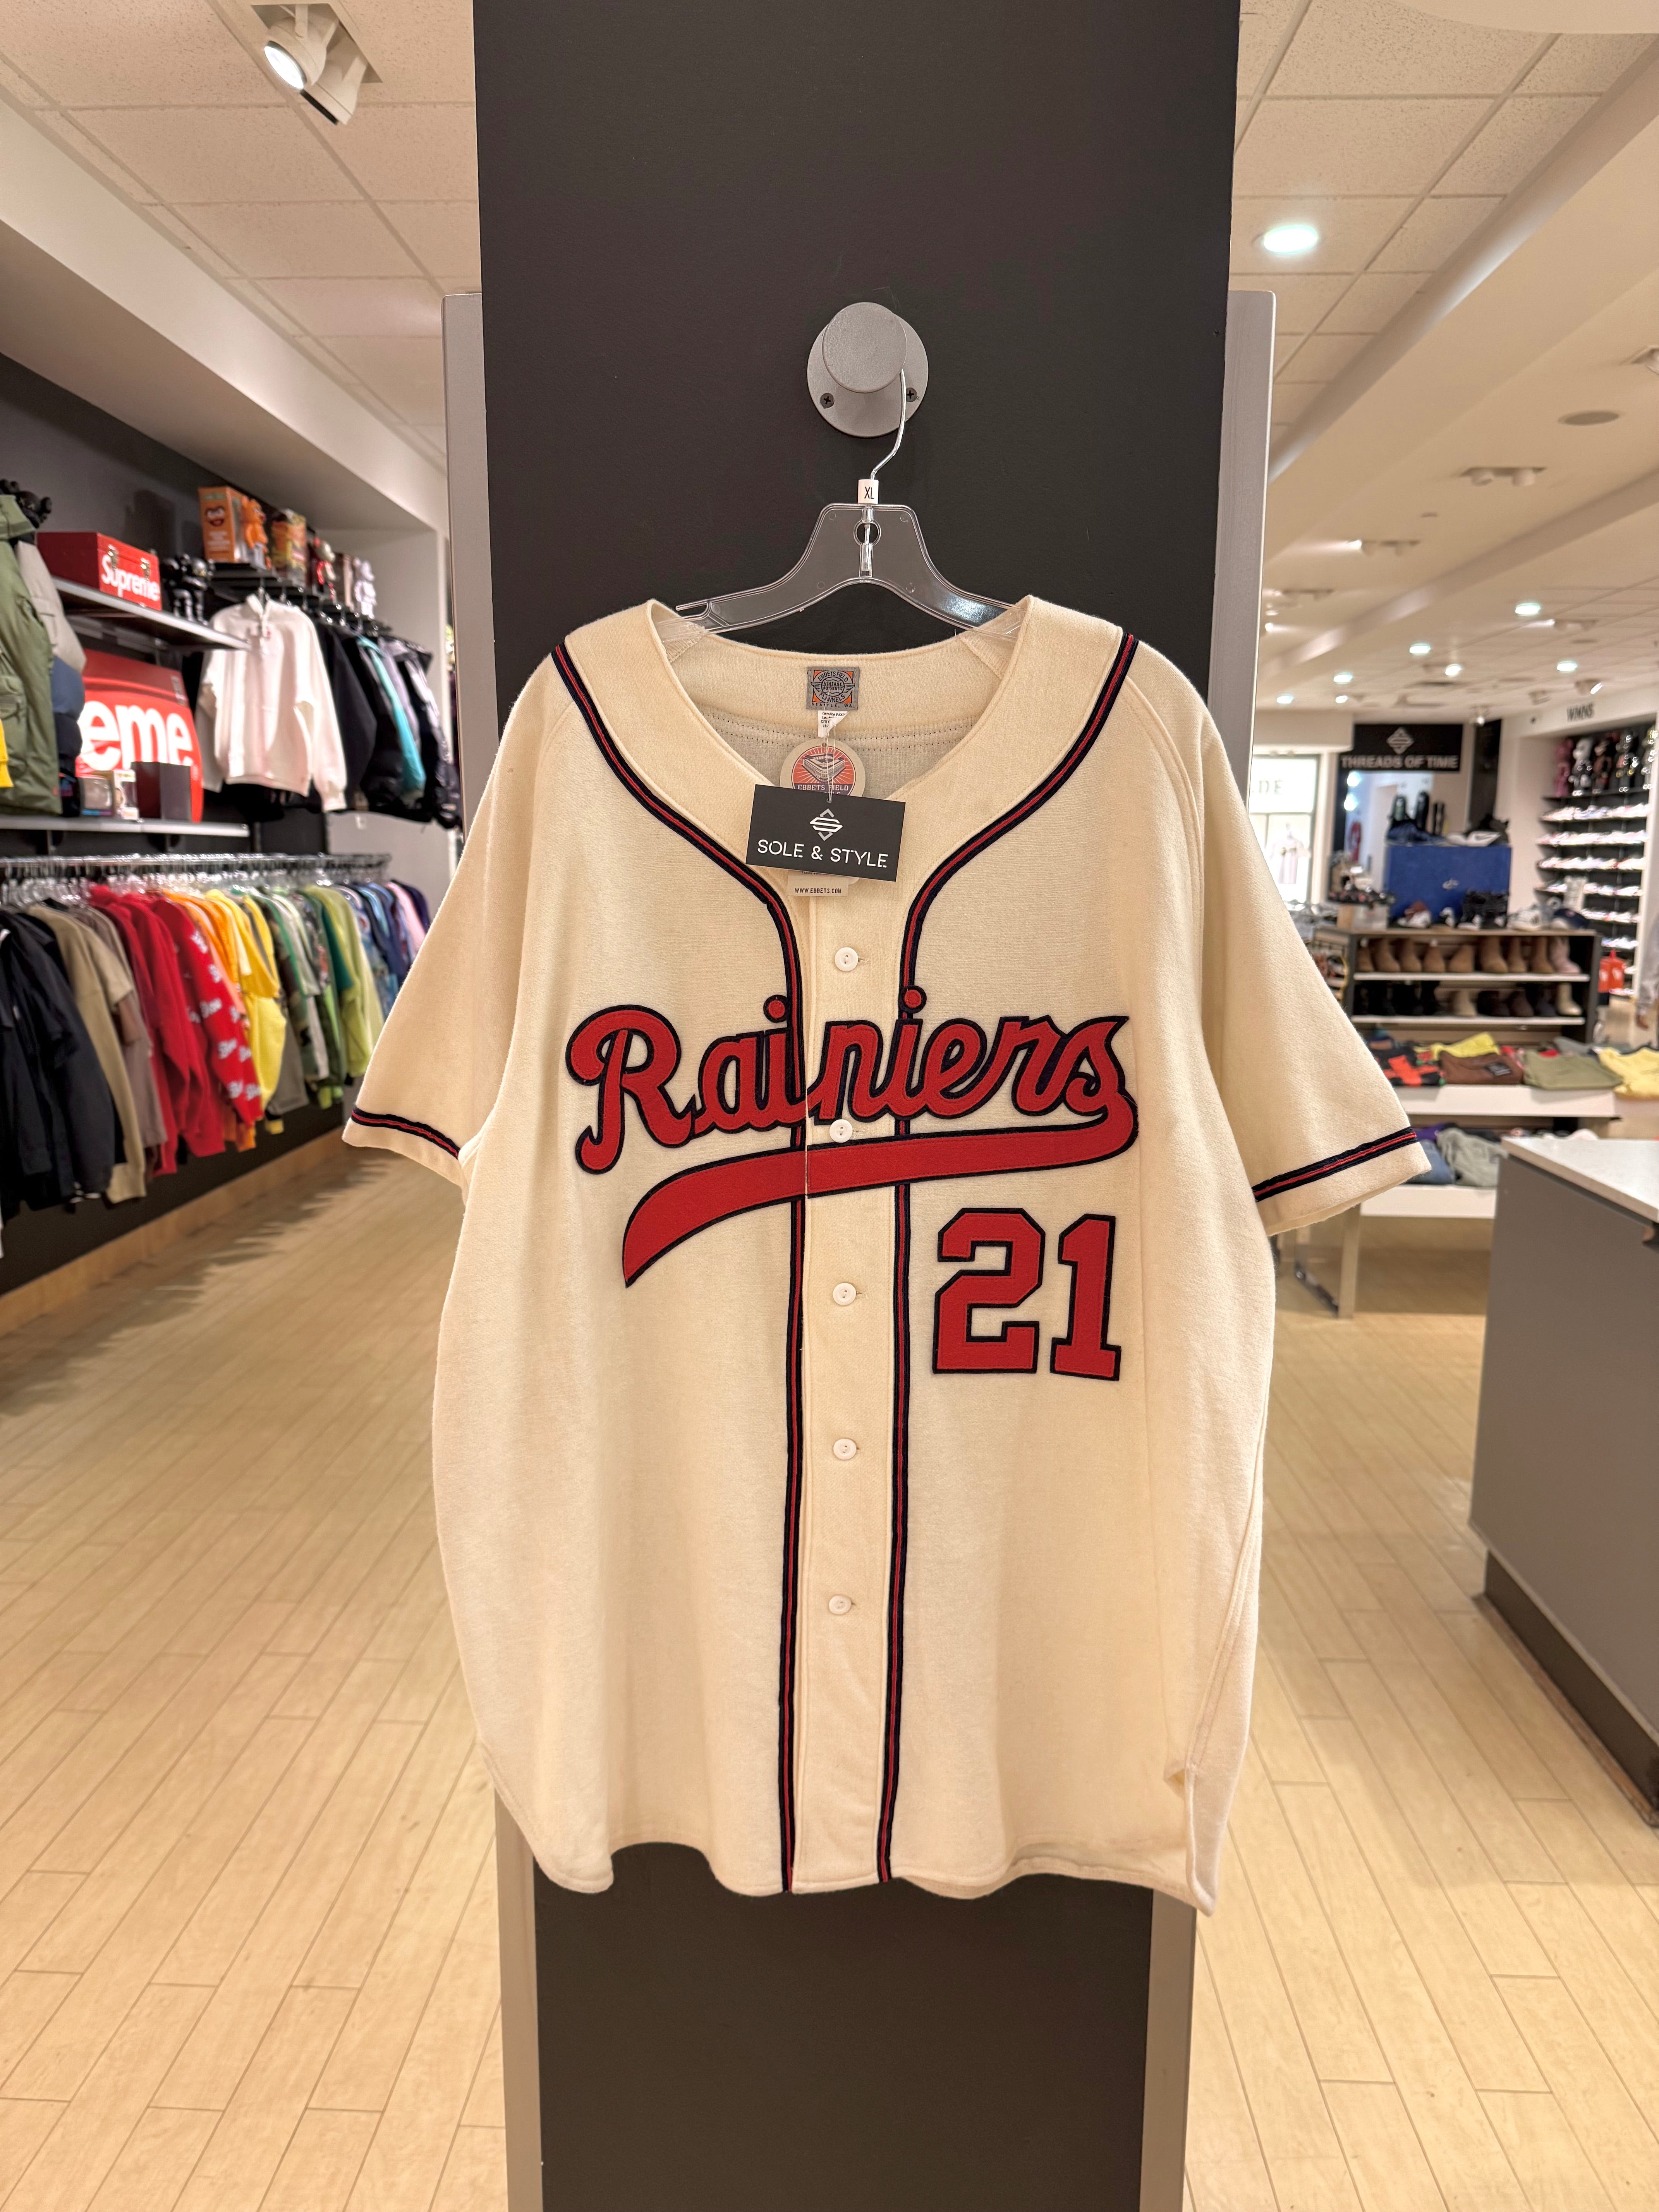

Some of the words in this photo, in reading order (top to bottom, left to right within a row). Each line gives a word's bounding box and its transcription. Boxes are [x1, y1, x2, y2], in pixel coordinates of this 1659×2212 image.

[864, 486, 874, 499] XL
[101, 554, 160, 601] Supreme
[818, 671, 836, 681] EBBETS
[836, 672, 848, 682] FIELD
[1567, 701, 1595, 722] WMNS
[1341, 756, 1403, 768] THREADS
[1405, 756, 1425, 768] OF
[1427, 755, 1459, 768] TIME
[757, 839, 804, 858] SOLE
[811, 846, 823, 860] &
[830, 848, 888, 868] STYLE
[566, 986, 1137, 1174] Rainiers
[932, 1207, 1121, 1381] 21
